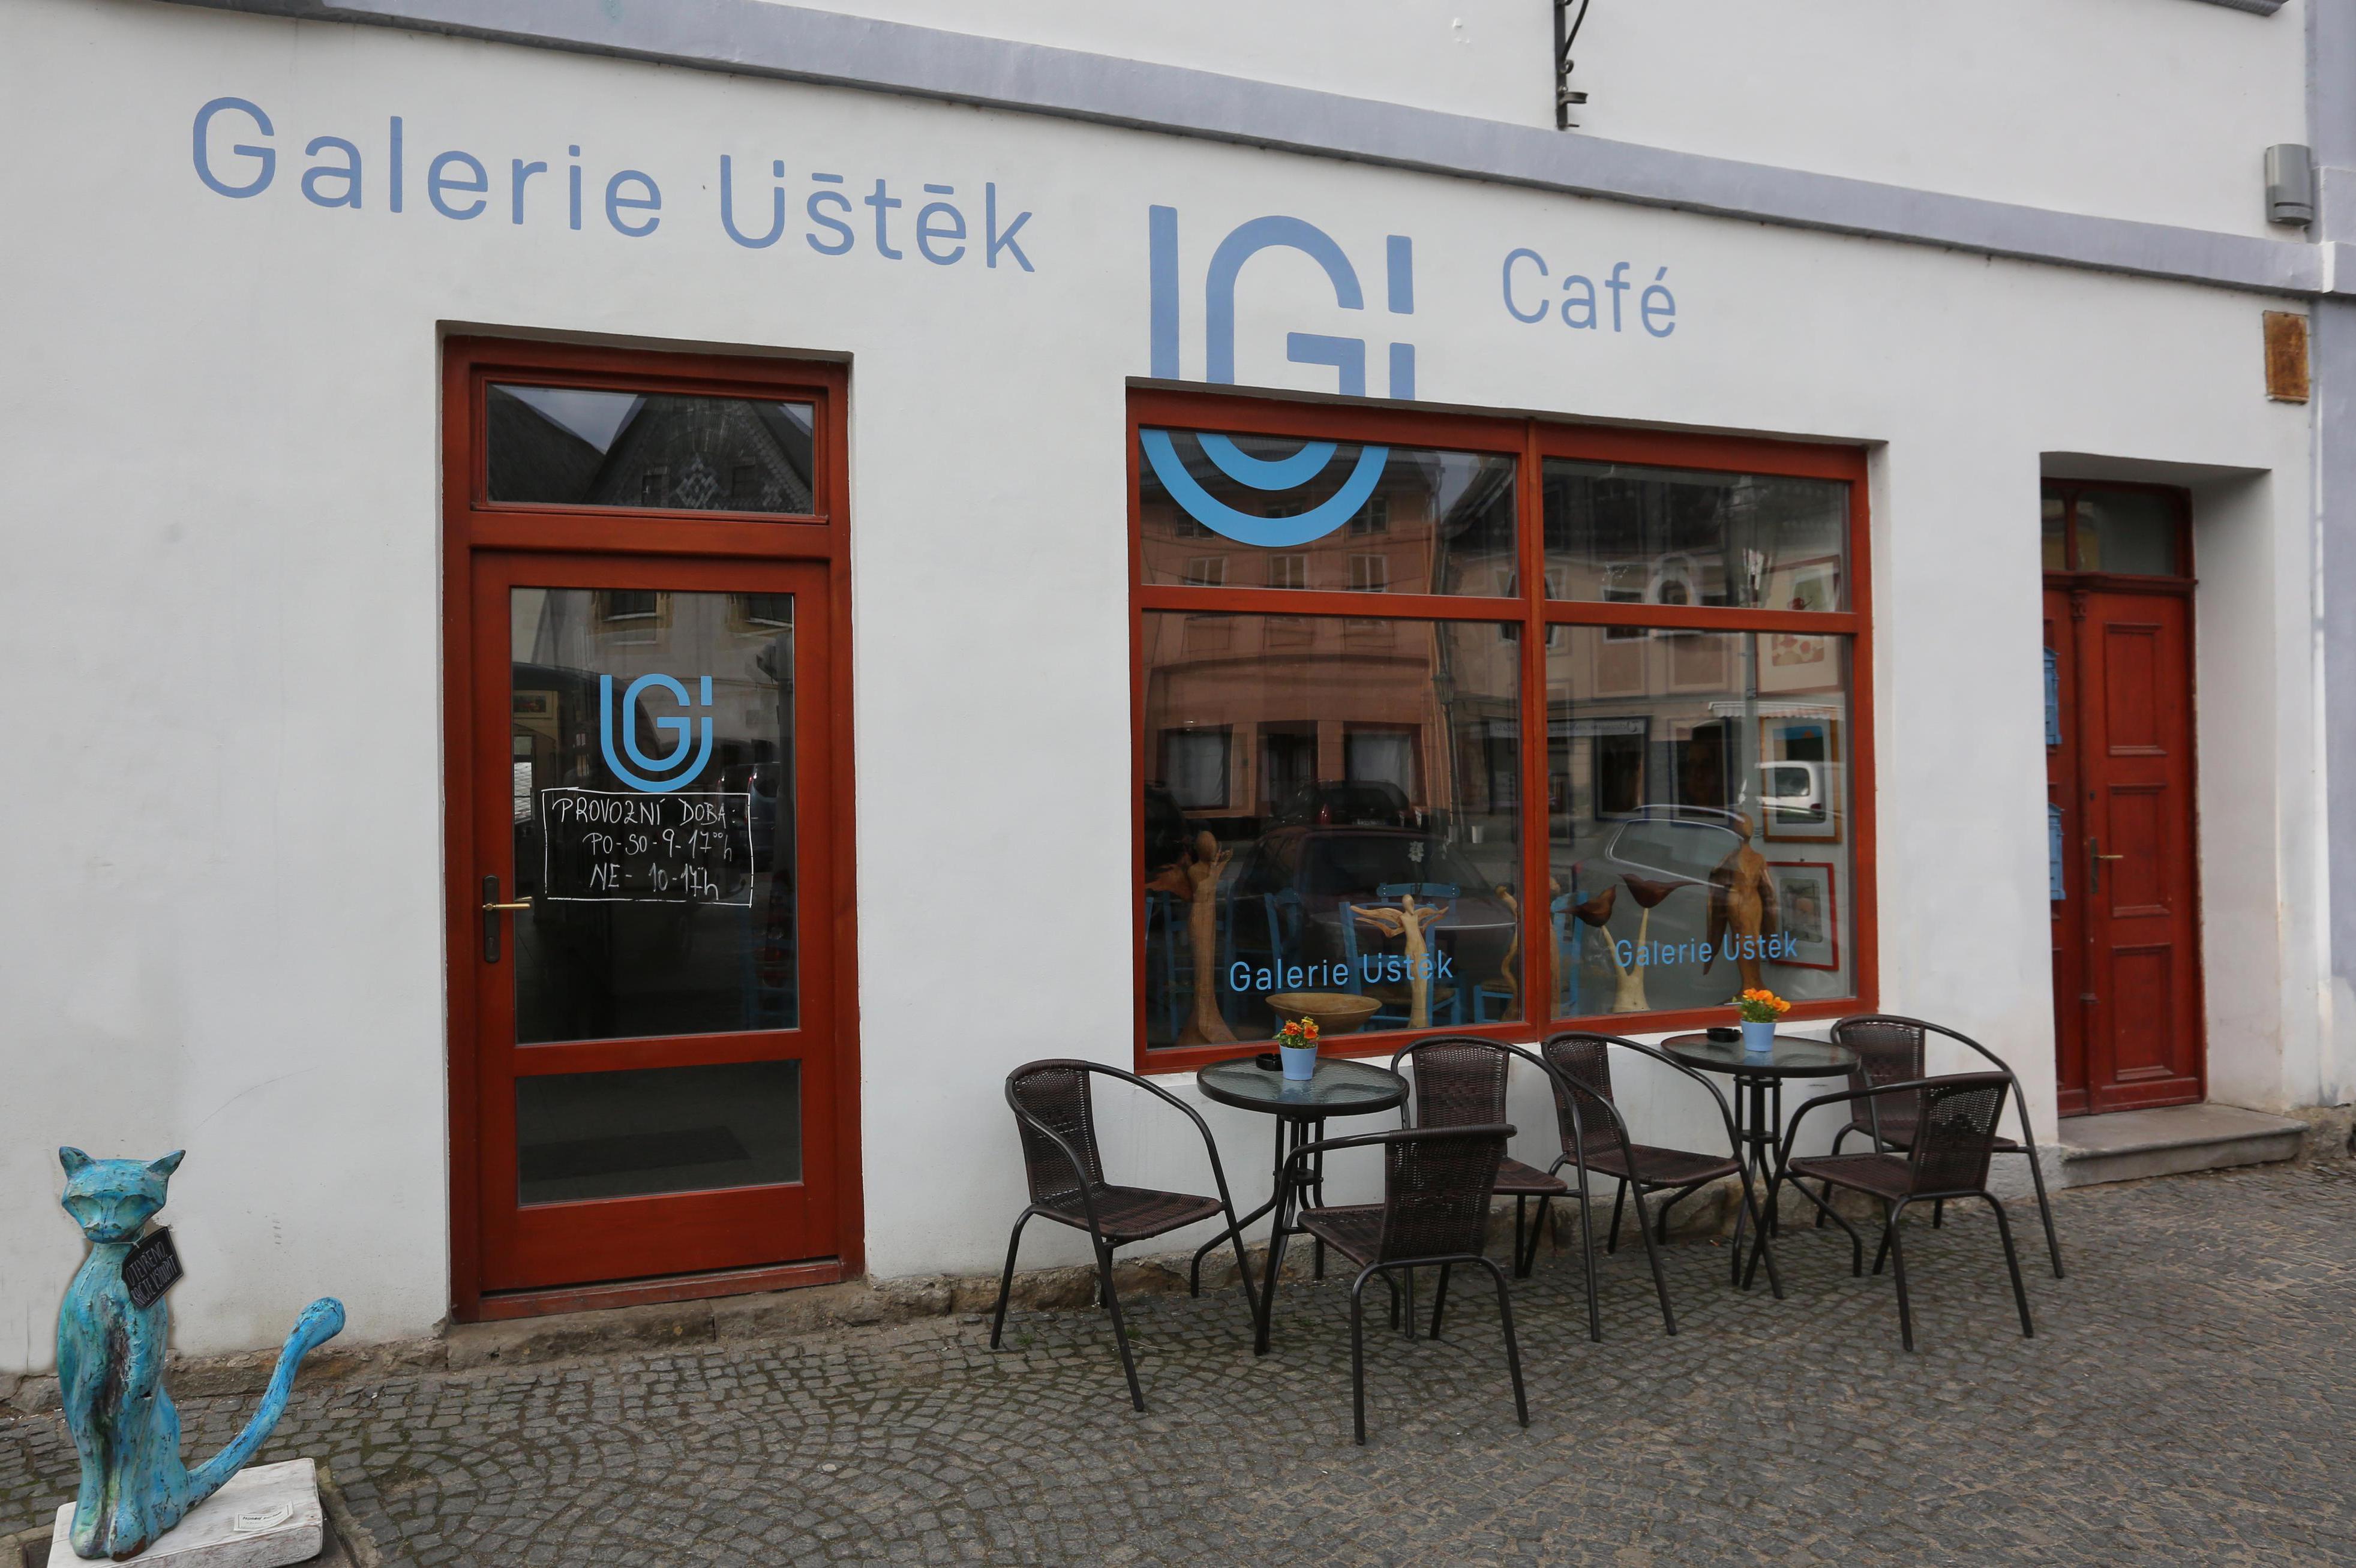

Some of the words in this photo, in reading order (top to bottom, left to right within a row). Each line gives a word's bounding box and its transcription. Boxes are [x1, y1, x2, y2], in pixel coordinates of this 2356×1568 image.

[193, 96, 662, 238] Galerie
[1502, 248, 1676, 338] Café
[552, 797, 665, 825] PROVOZNÍ
[678, 798, 736, 829] DOBA:
[1614, 938, 1712, 968] Galerie
[1229, 959, 1349, 992] Galerie
